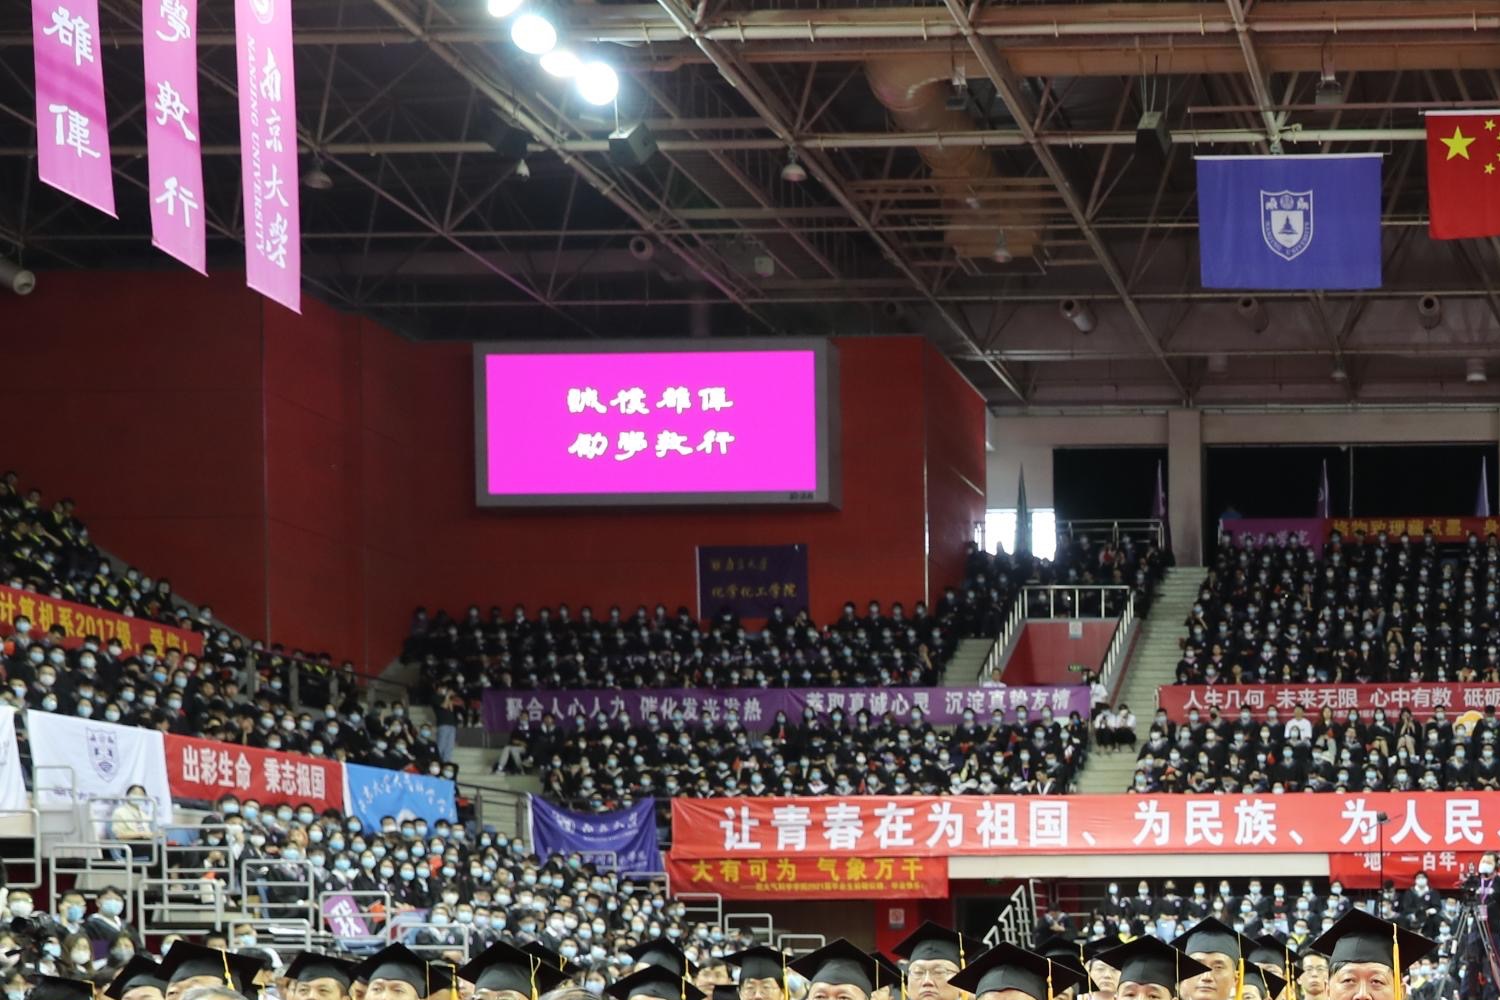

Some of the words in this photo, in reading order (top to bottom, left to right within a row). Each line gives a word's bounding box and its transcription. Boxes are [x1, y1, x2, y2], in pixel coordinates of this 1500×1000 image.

[1184, 689, 1265, 710] 人生几何
[1276, 688, 1359, 710] 未来无限
[1369, 686, 1453, 709] 心中有数
[182, 744, 252, 791] 出彩生命
[691, 857, 798, 883] 大有可为
[816, 856, 925, 882] 气象万千
